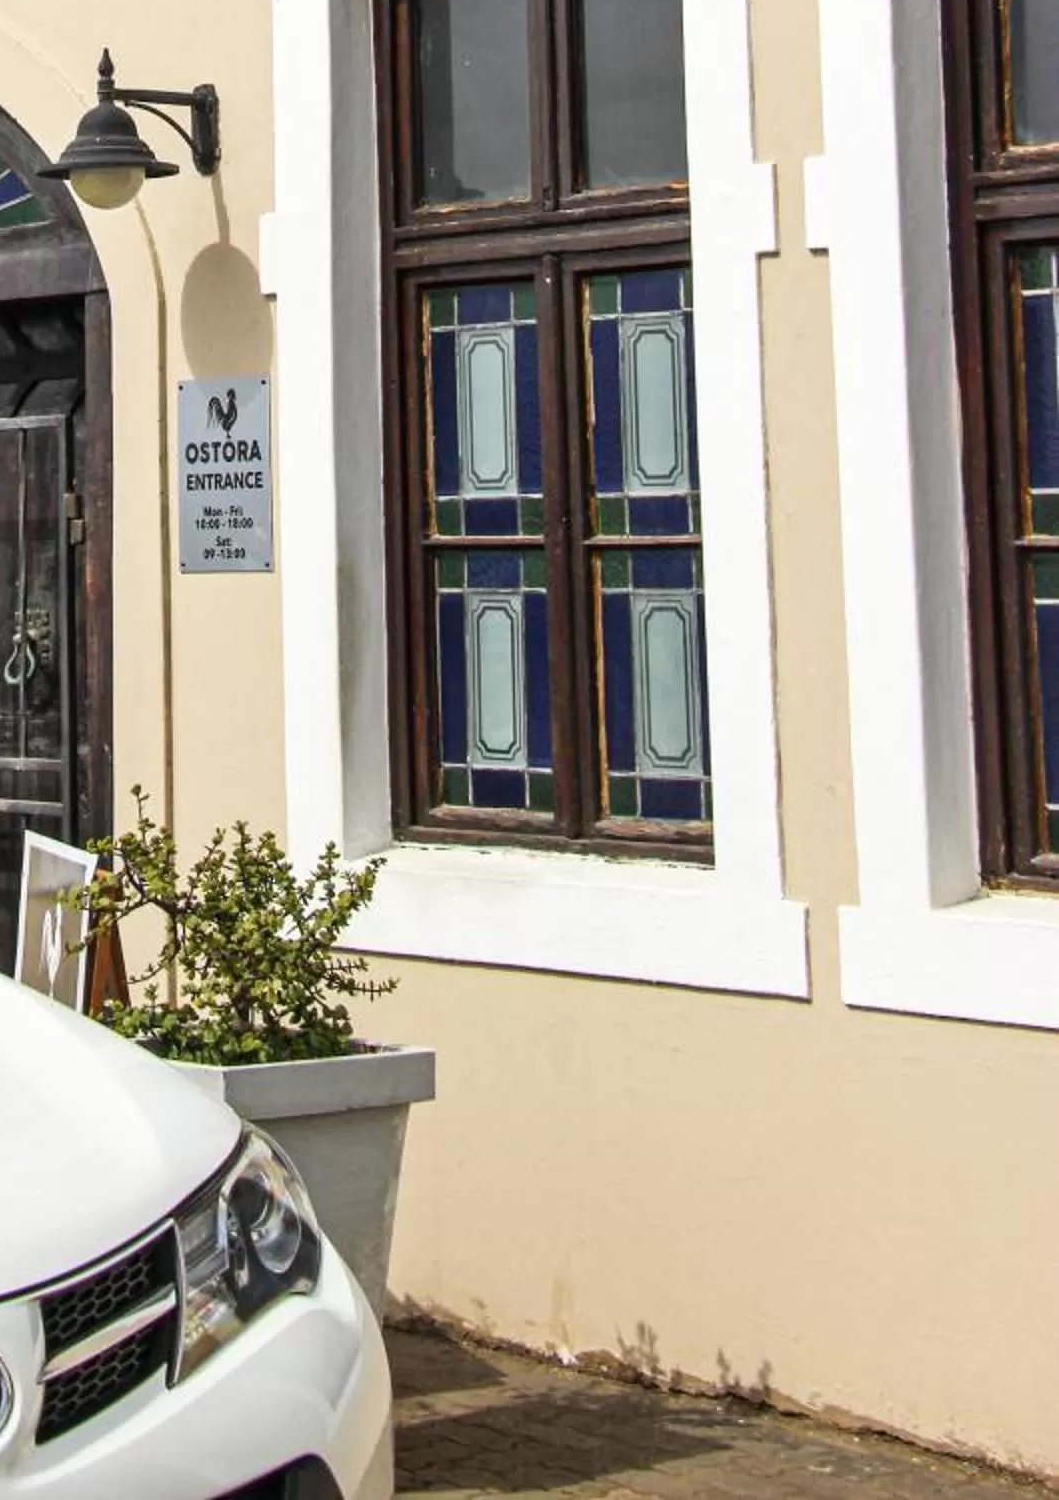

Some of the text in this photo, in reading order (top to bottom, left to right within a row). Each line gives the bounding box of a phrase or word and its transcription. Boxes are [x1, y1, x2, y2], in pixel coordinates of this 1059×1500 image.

[185, 439, 262, 465] OSTORA
[186, 471, 264, 491] ENTRANCE
[203, 506, 223, 517] Mon
